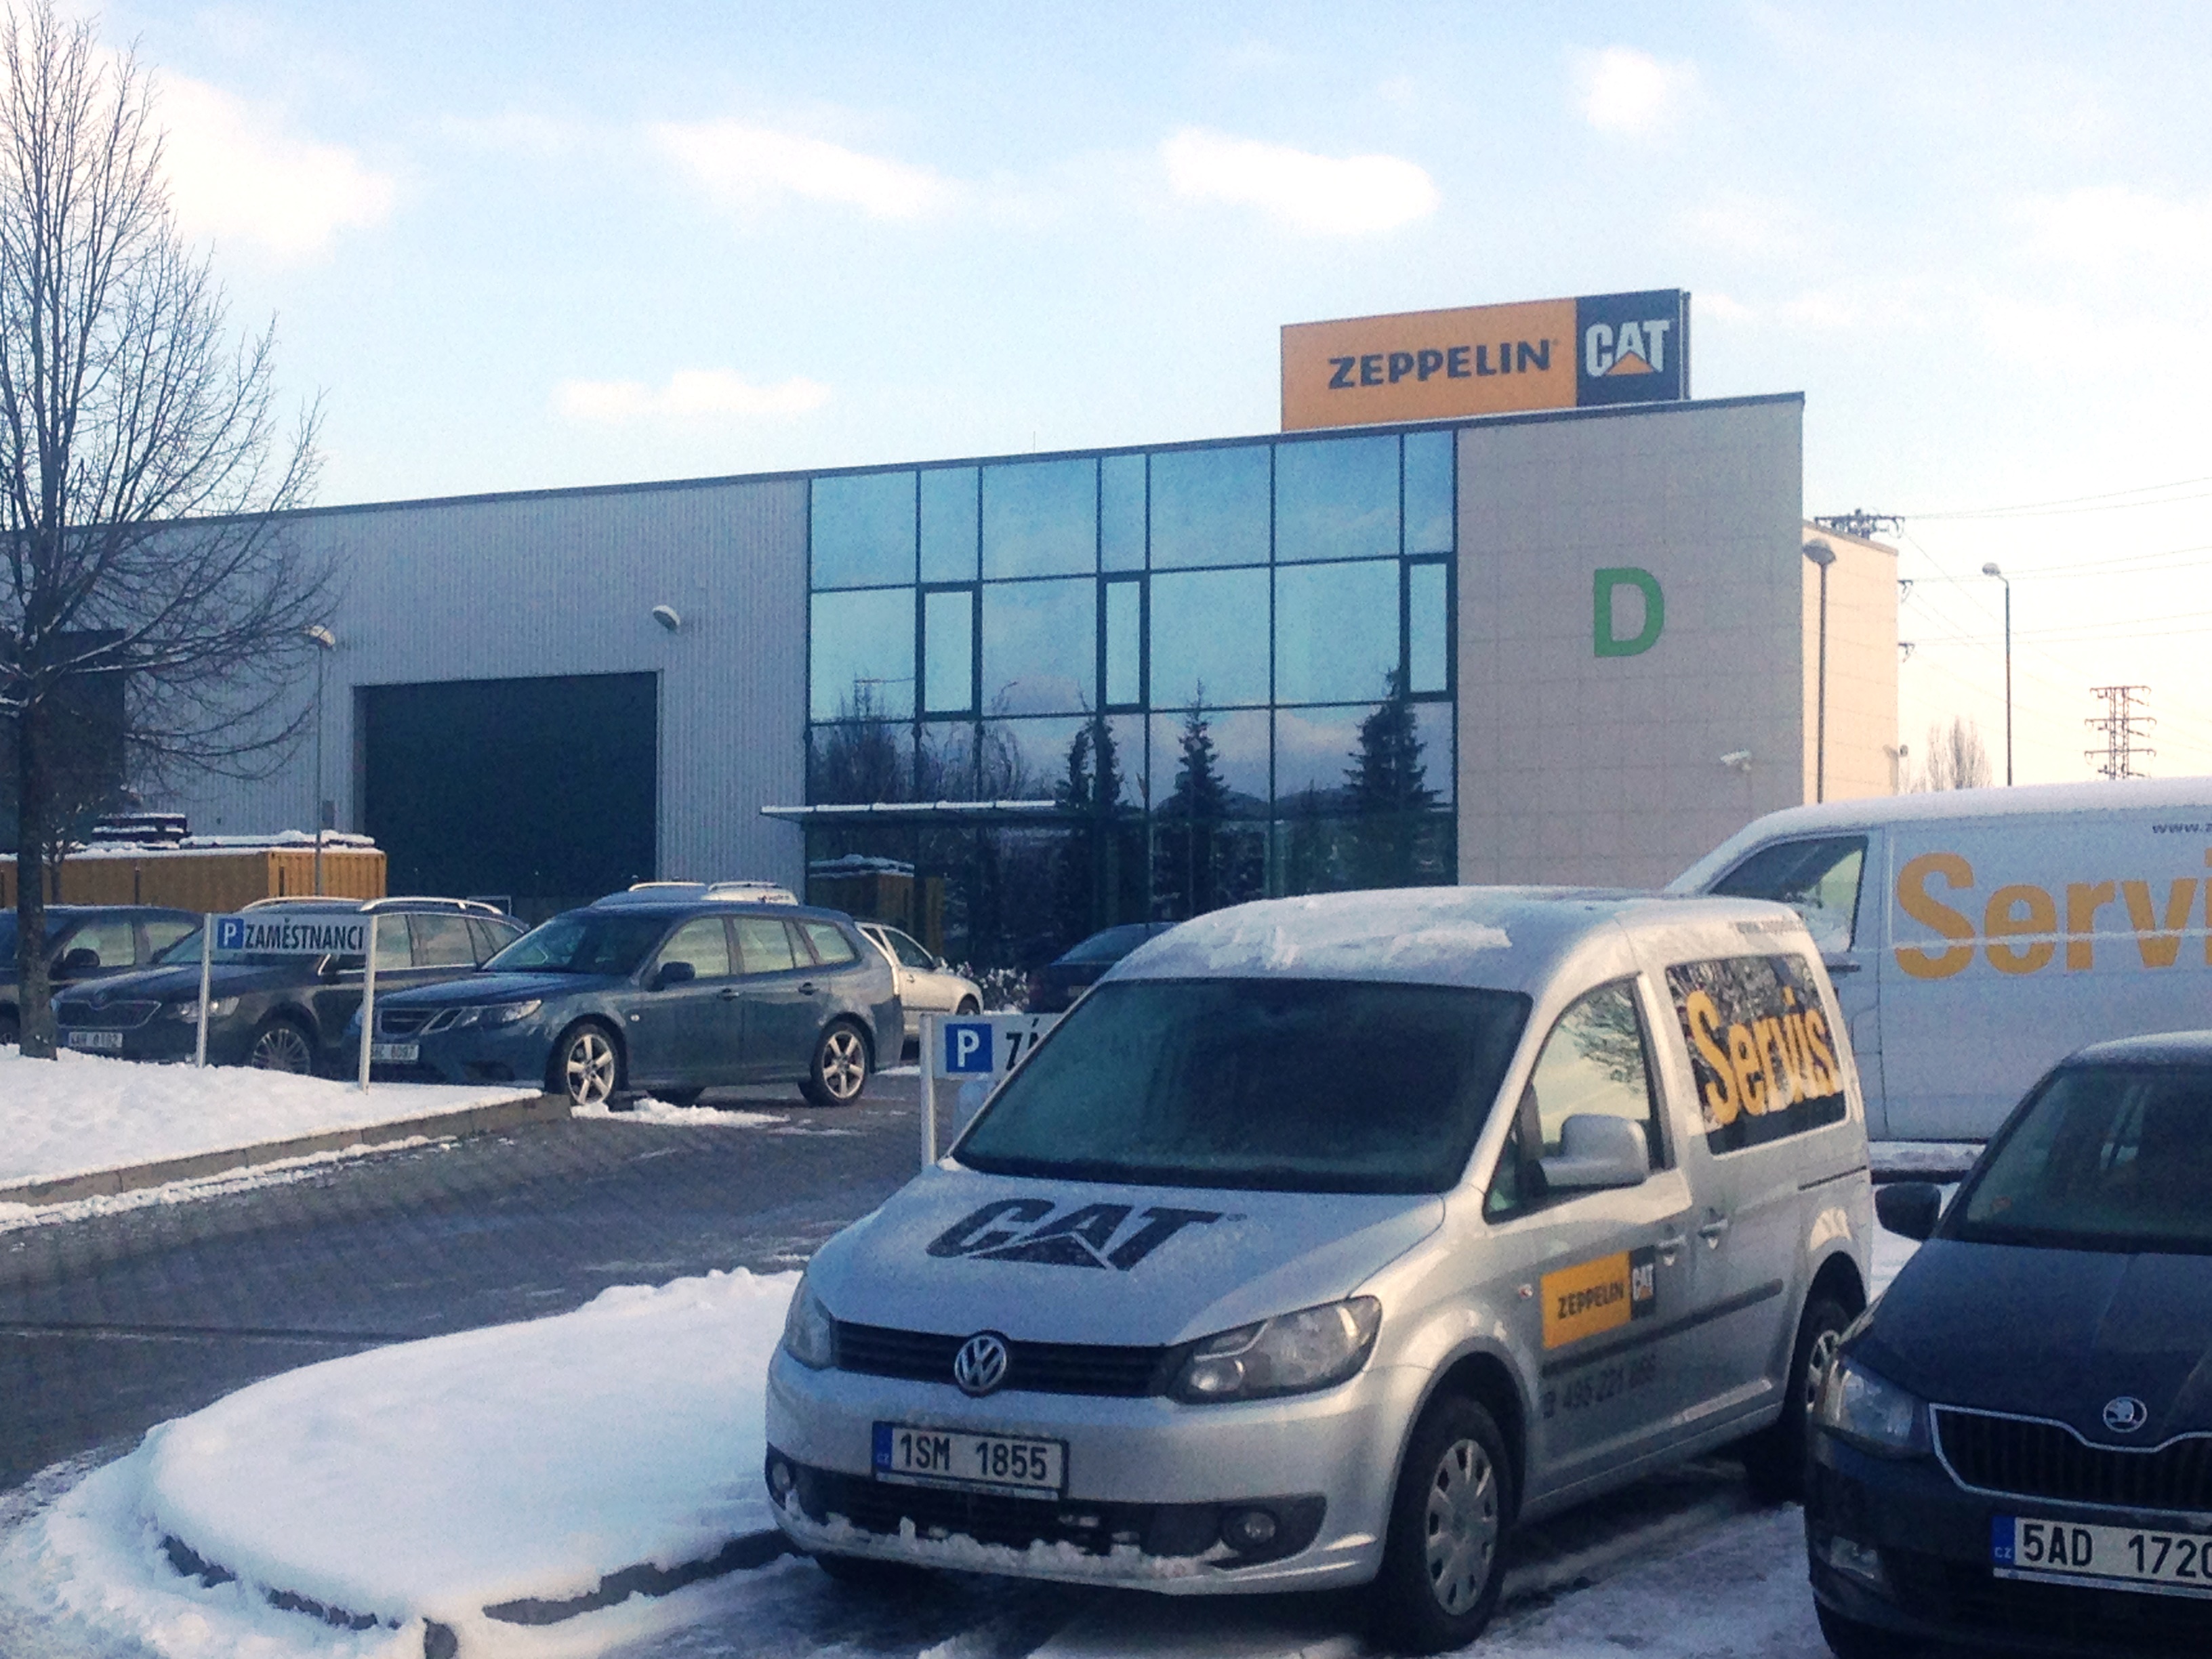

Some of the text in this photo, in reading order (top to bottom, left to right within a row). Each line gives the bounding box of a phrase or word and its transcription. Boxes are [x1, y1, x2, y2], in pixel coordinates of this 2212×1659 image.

[1328, 339, 1551, 390] ZEPPELIN
[1586, 319, 1670, 377] CAT
[1594, 567, 1665, 657] D
[224, 918, 364, 950] P ZAMĚSTNANCI
[958, 1029, 979, 1067] P
[1686, 986, 1841, 1125] Servis
[926, 1198, 1225, 1271] CAT
[1558, 1282, 1624, 1319] ZEPPELIN
[900, 1433, 950, 1471] 1SM
[976, 1441, 1047, 1481] 1855
[2023, 1524, 2093, 1566] 5AD
